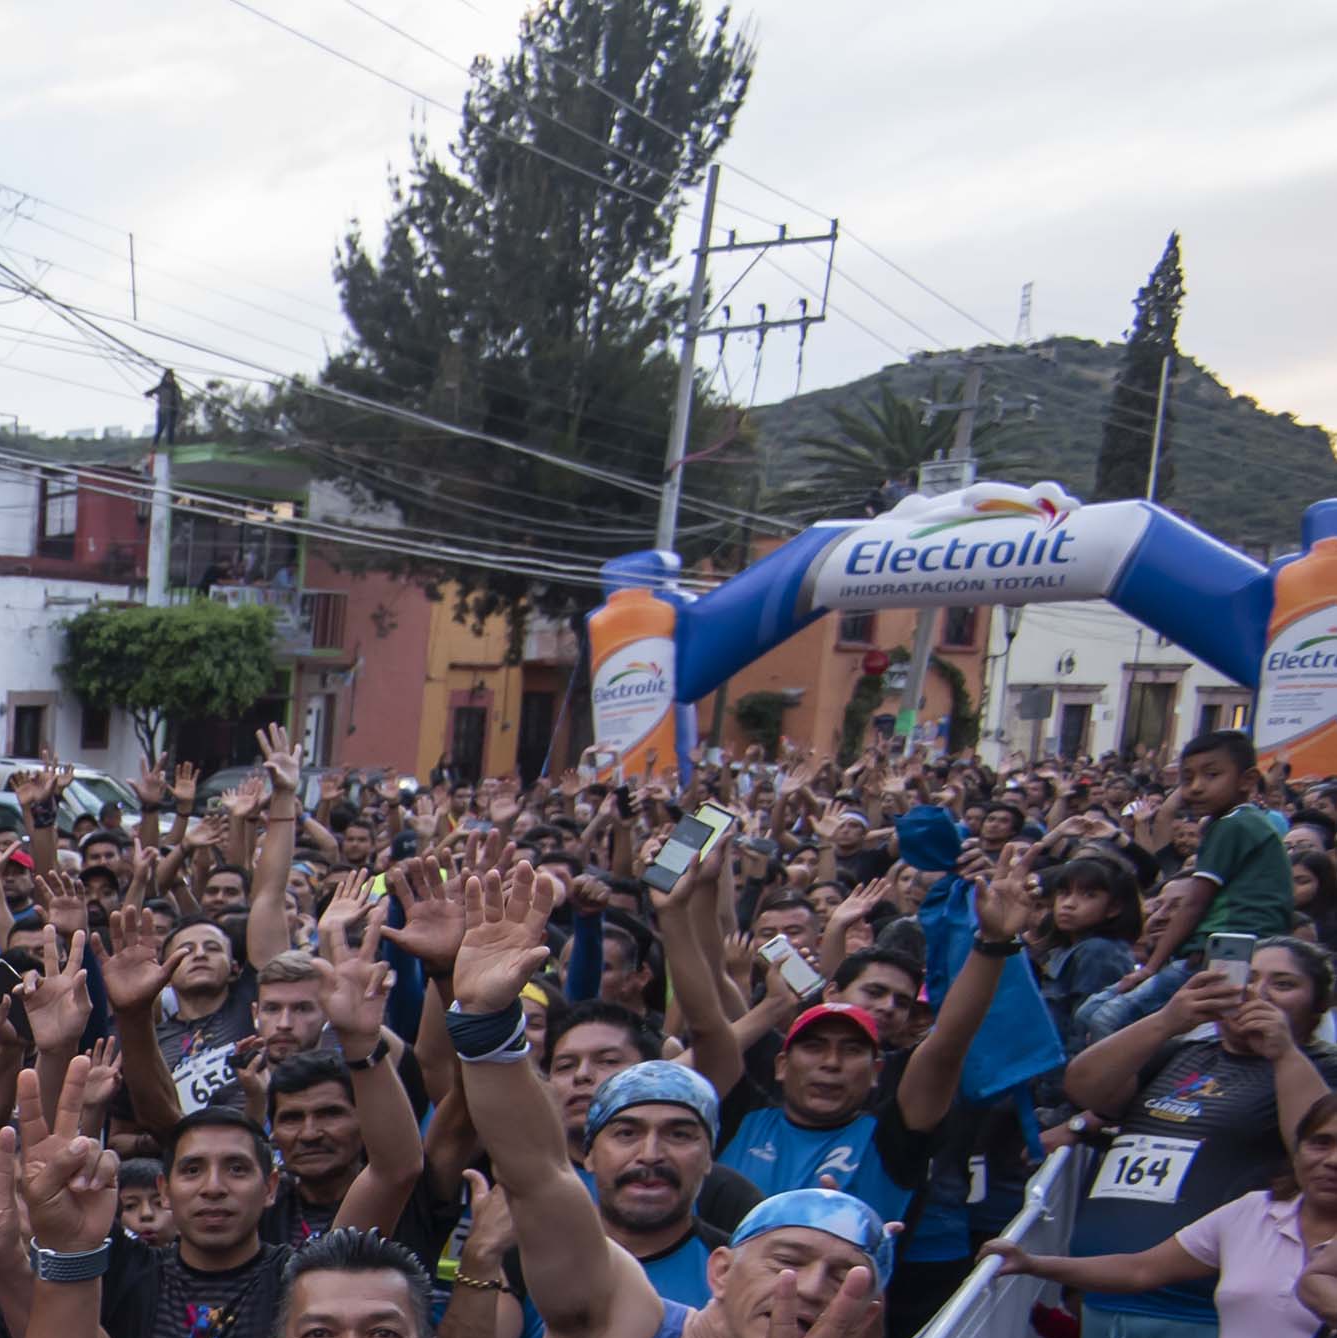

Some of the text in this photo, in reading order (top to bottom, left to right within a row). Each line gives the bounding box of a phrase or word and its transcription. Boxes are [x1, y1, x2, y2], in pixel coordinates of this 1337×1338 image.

[844, 533, 1075, 577] Electrolit
[994, 574, 1066, 594] TOTAL!
[1267, 647, 1337, 673] Electr
[1113, 1155, 1169, 1188] 164
